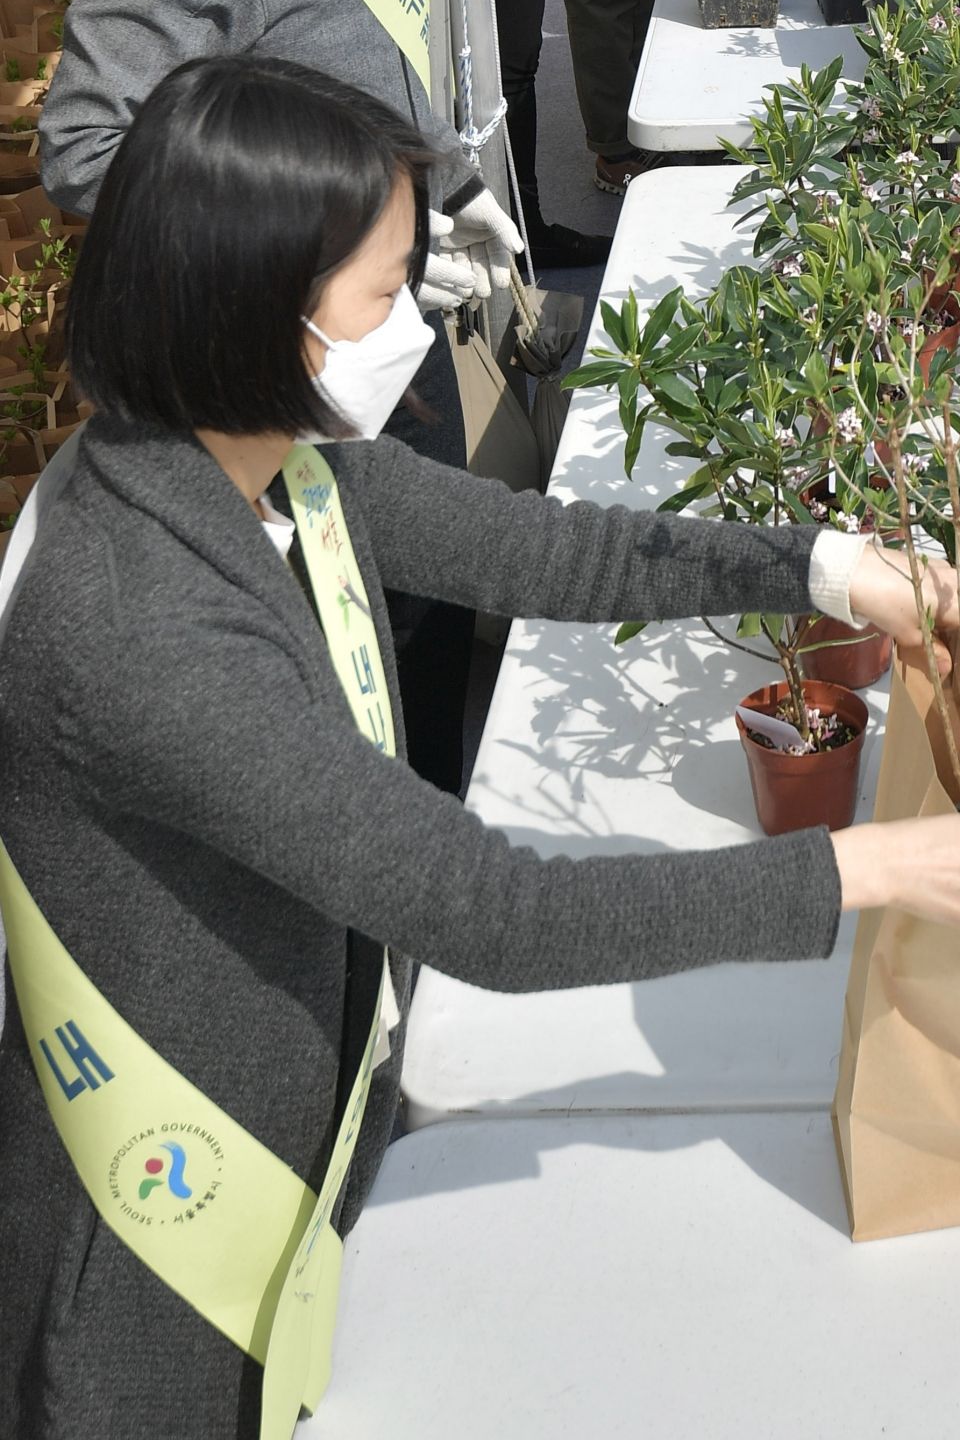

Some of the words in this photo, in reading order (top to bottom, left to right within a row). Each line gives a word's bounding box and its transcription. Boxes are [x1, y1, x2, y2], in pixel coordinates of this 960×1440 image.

[39, 1019, 116, 1102] 내
[108, 1127, 155, 1200] METROPOLITAN
[161, 1122, 225, 1161] GOVERNMENT
[119, 1201, 154, 1225] SEOUL
